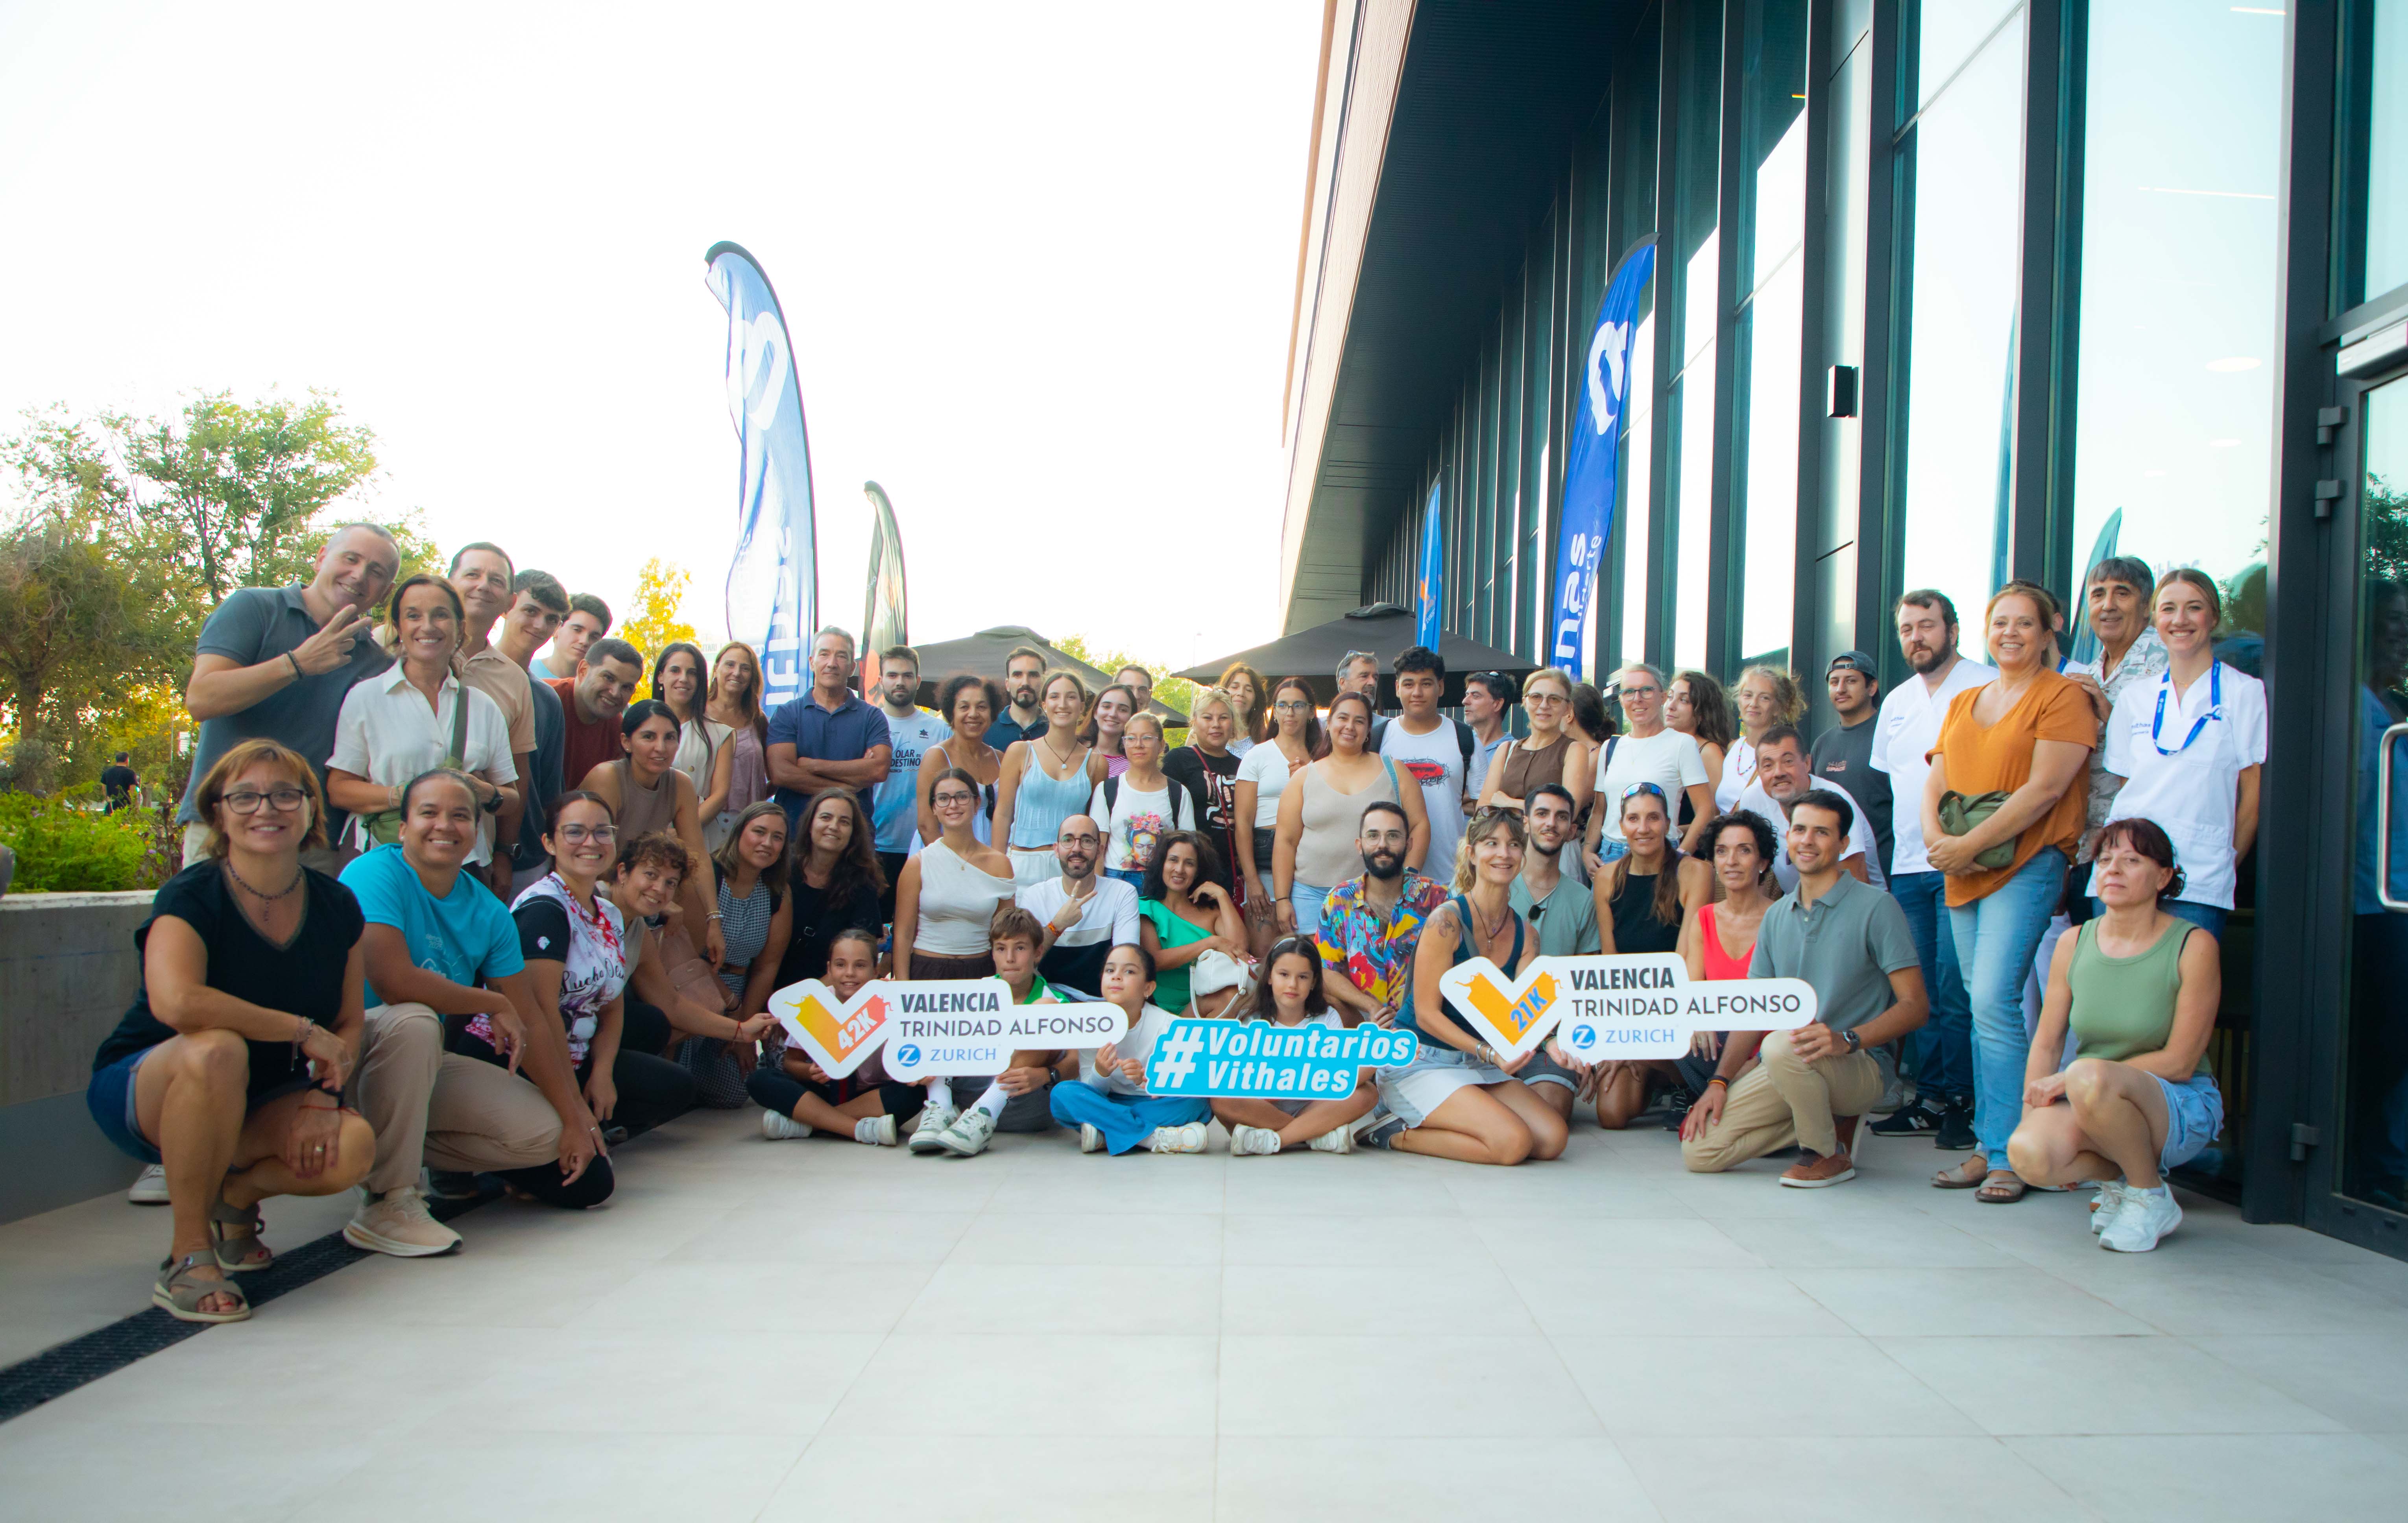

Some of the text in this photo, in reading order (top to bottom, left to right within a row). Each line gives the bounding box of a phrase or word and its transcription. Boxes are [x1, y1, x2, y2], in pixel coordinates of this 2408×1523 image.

[1570, 967, 1675, 991] VALENCIA
[901, 993, 999, 1013] VALENCIA
[1511, 985, 1547, 1032] 21K
[1572, 994, 1801, 1017] TRINIDAD ALFONSO
[838, 1007, 877, 1050] 42K
[900, 1016, 1114, 1037] TRINIDAD ALFONSO
[1606, 1030, 1674, 1043] ZURICH
[930, 1048, 996, 1061] ZURICH
[1208, 1061, 1350, 1092] Vithales
